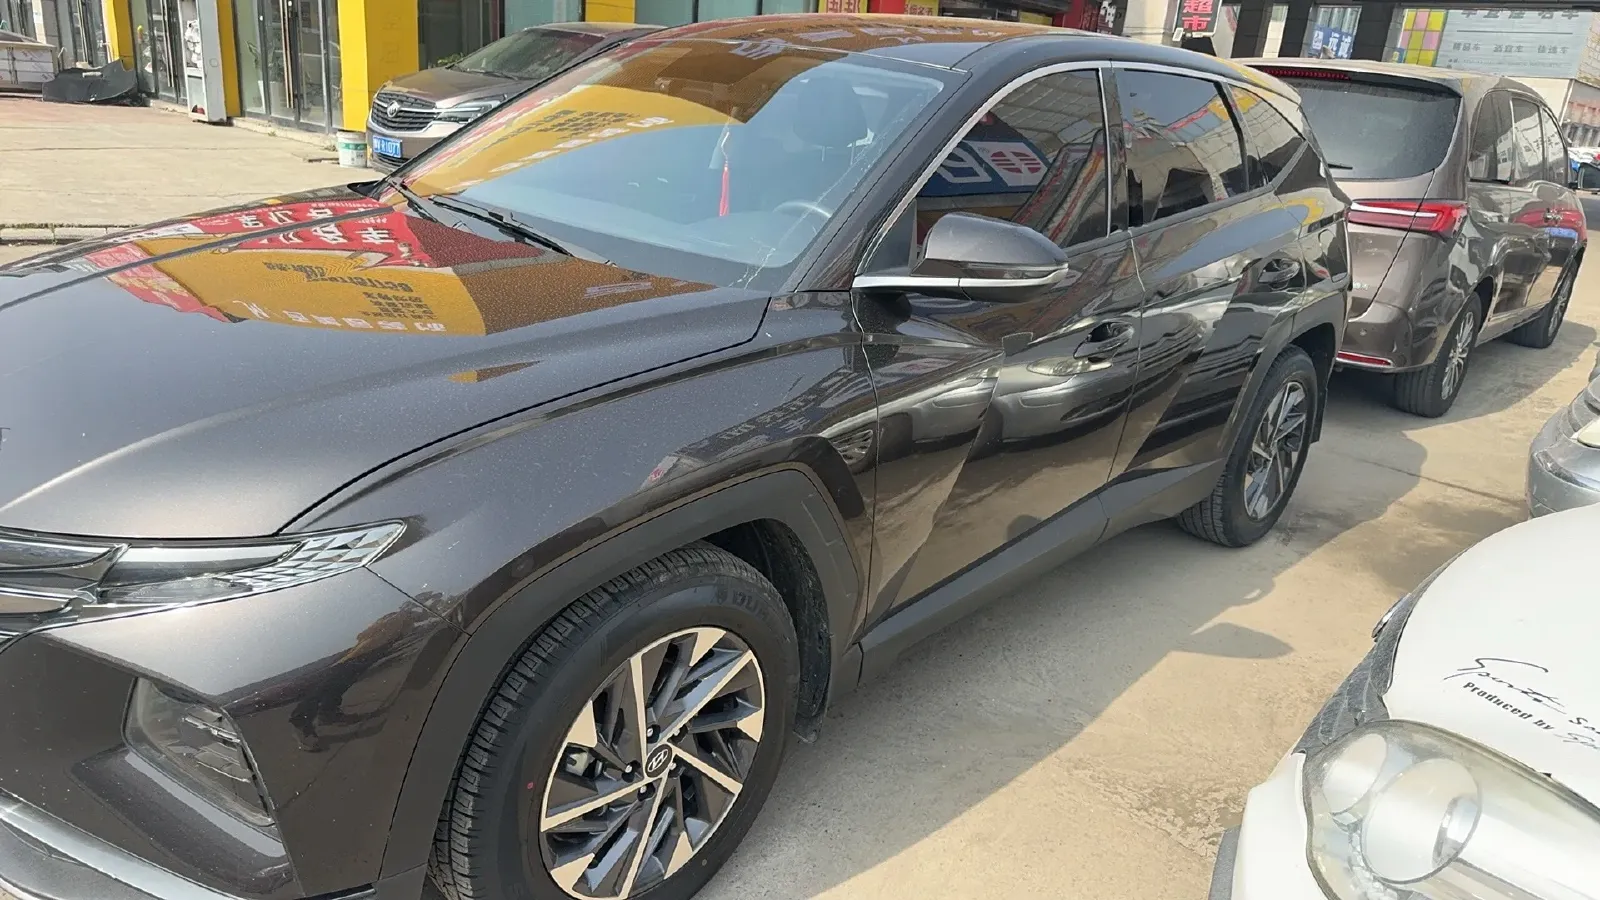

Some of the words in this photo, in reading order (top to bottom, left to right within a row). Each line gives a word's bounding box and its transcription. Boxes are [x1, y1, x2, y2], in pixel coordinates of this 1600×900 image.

[1182, 0, 1213, 30] 超市
[1463, 681, 1533, 720] Produced
[1533, 719, 1555, 731] by
